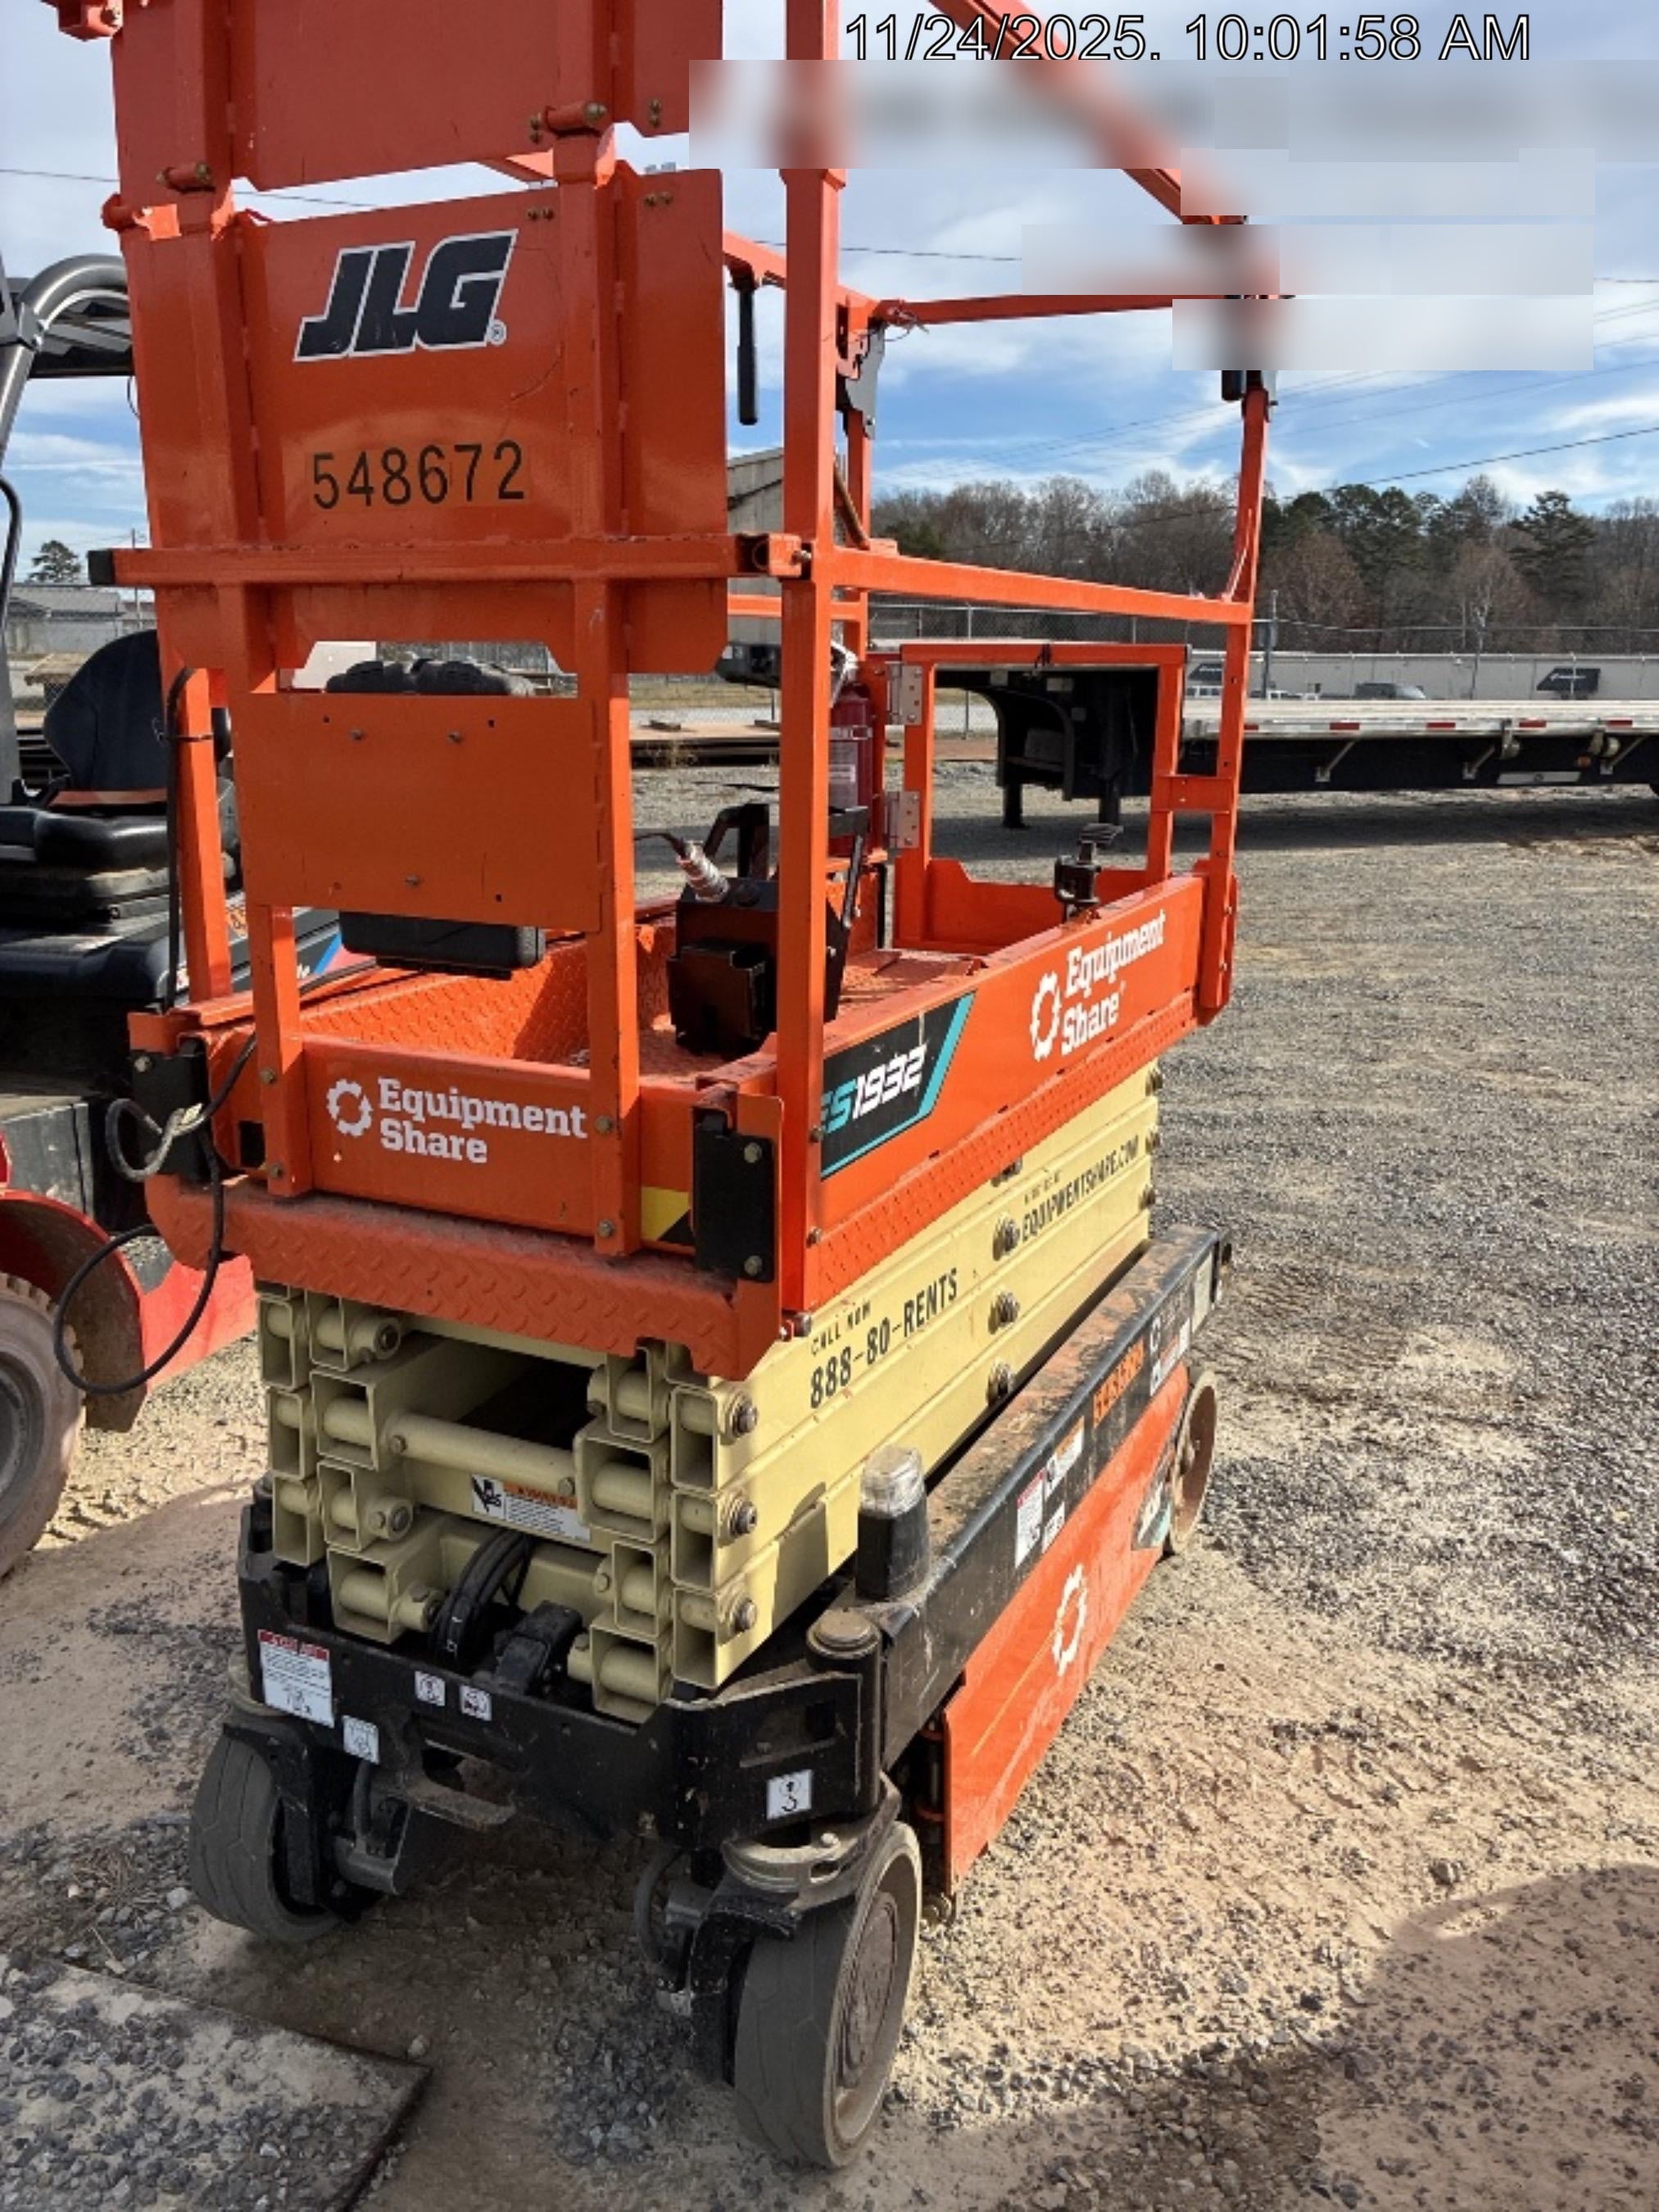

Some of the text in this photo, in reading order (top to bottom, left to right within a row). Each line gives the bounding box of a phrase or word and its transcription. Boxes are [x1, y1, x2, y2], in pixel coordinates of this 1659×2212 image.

[292, 229, 519, 361] JLG
[313, 439, 524, 510] 548672
[1065, 909, 1166, 998] Equipment
[1062, 991, 1120, 1055] Share
[378, 1077, 588, 1139] Equipment
[380, 1117, 487, 1163] Share
[810, 1267, 958, 1409] 888-80-RENTS
